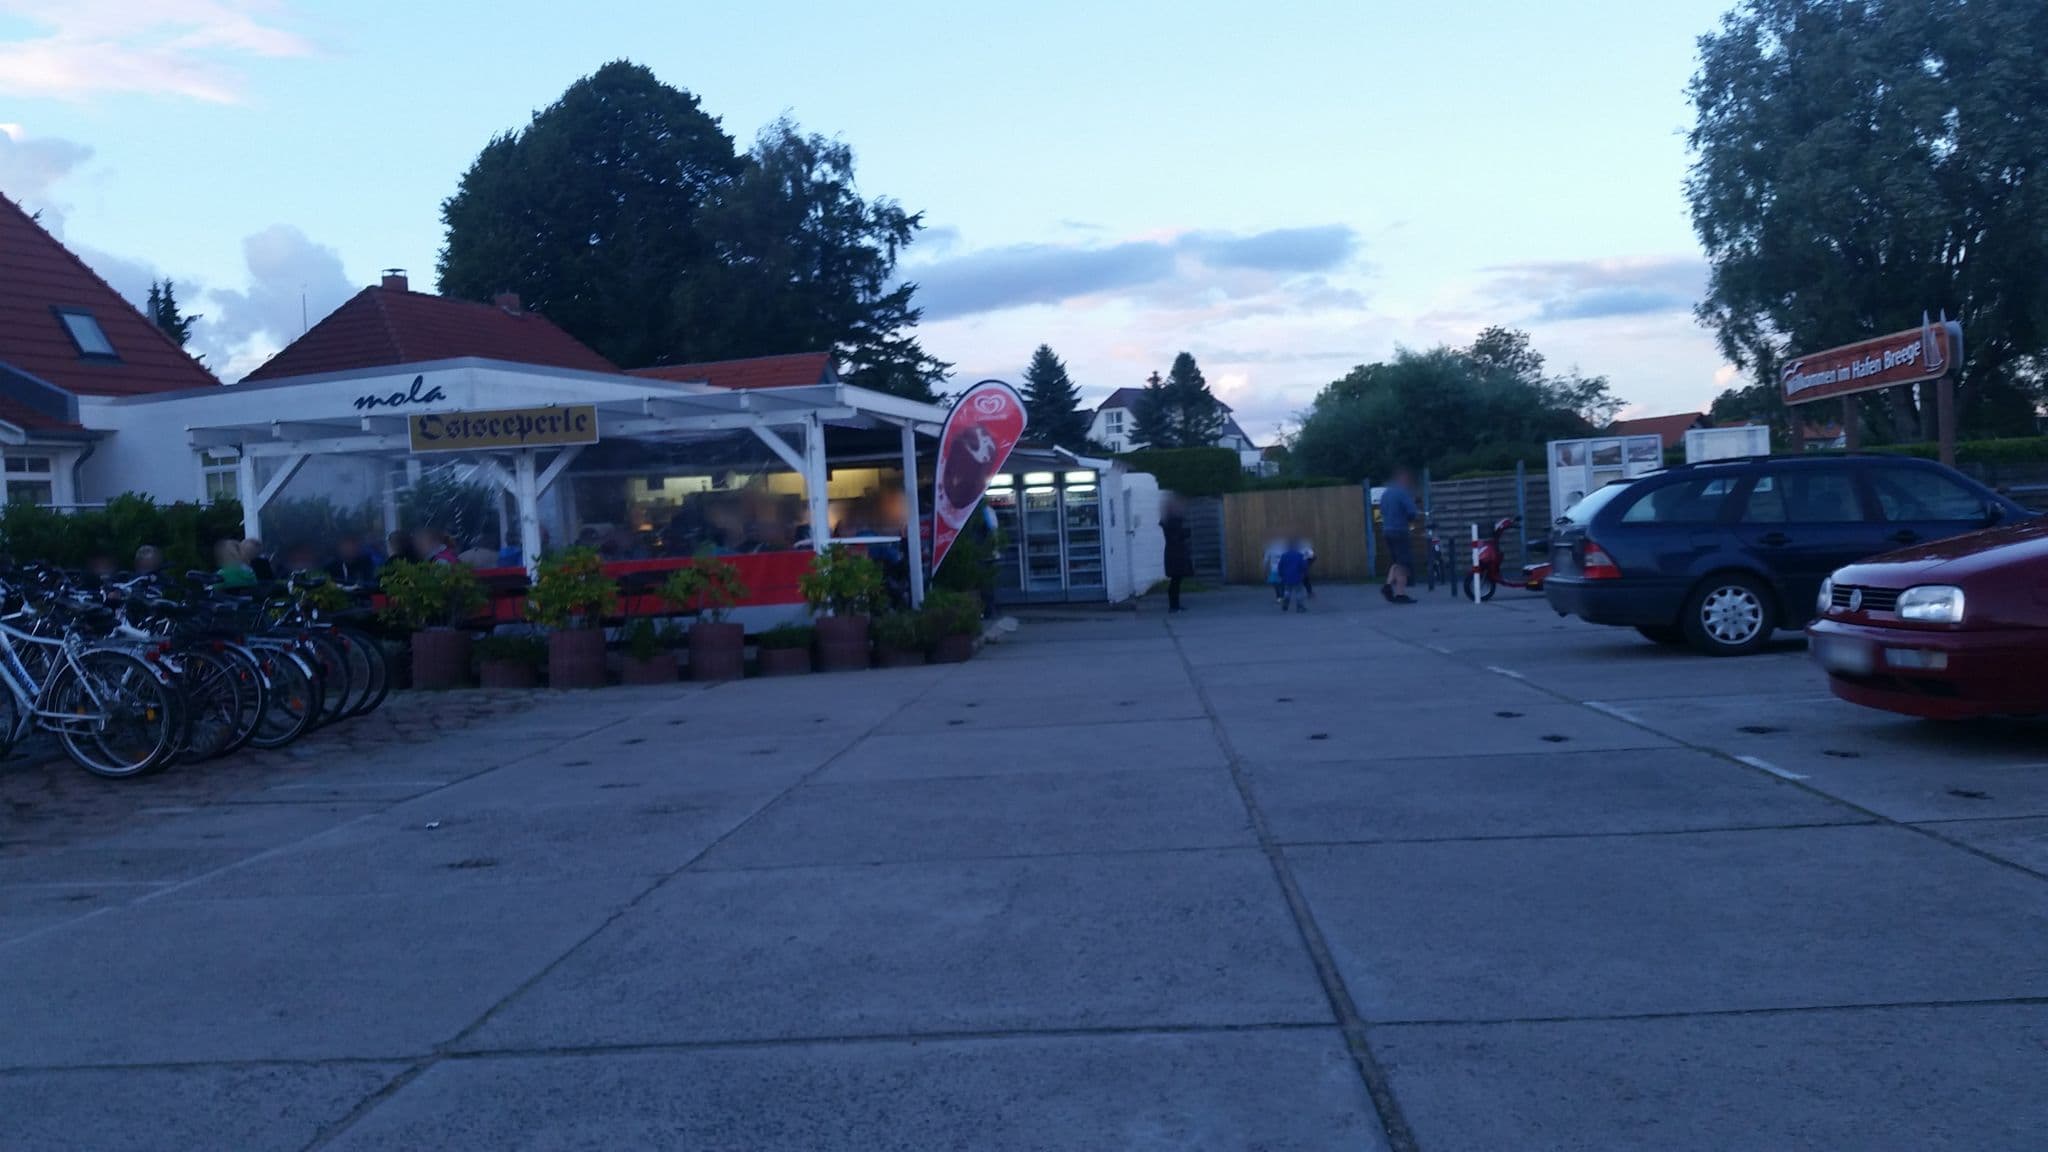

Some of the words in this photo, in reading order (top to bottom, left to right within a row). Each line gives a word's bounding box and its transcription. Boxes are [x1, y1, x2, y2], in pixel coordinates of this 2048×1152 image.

[1852, 355, 1882, 379] Hafen
[1883, 340, 1921, 370] Breege
[353, 374, 447, 411] mola
[418, 407, 588, 442] Ostseeperle
